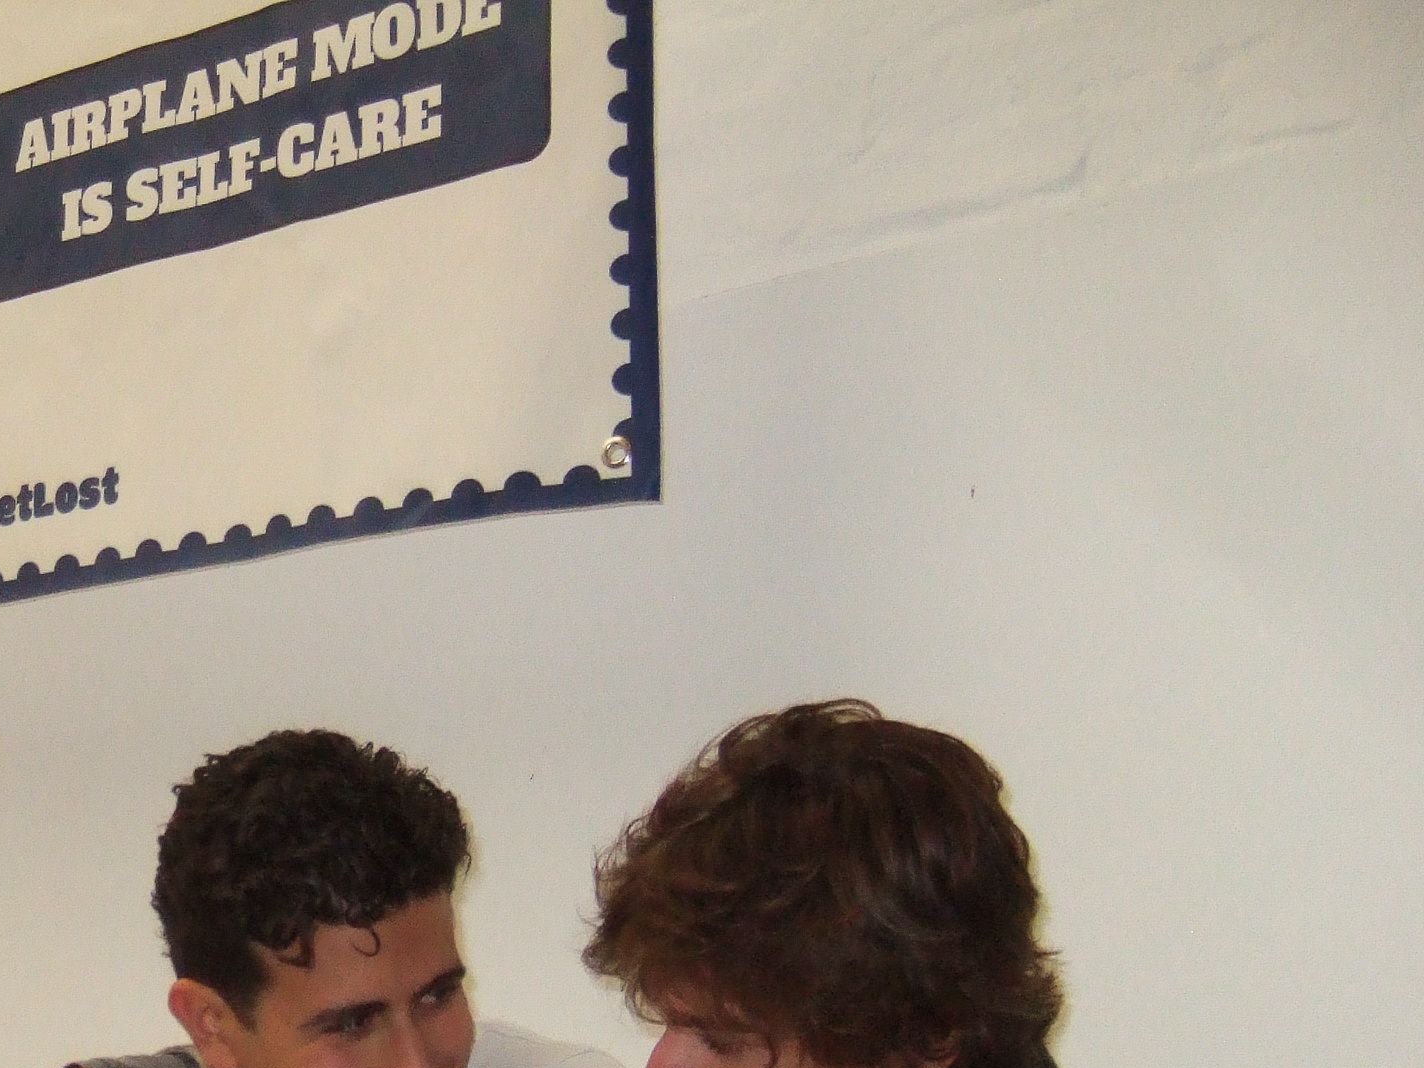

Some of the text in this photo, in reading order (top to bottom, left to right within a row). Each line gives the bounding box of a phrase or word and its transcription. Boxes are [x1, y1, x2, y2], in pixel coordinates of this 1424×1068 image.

[15, 0, 502, 172] AIRPLANE MODE
[61, 84, 443, 242] IS SELF-CARE
